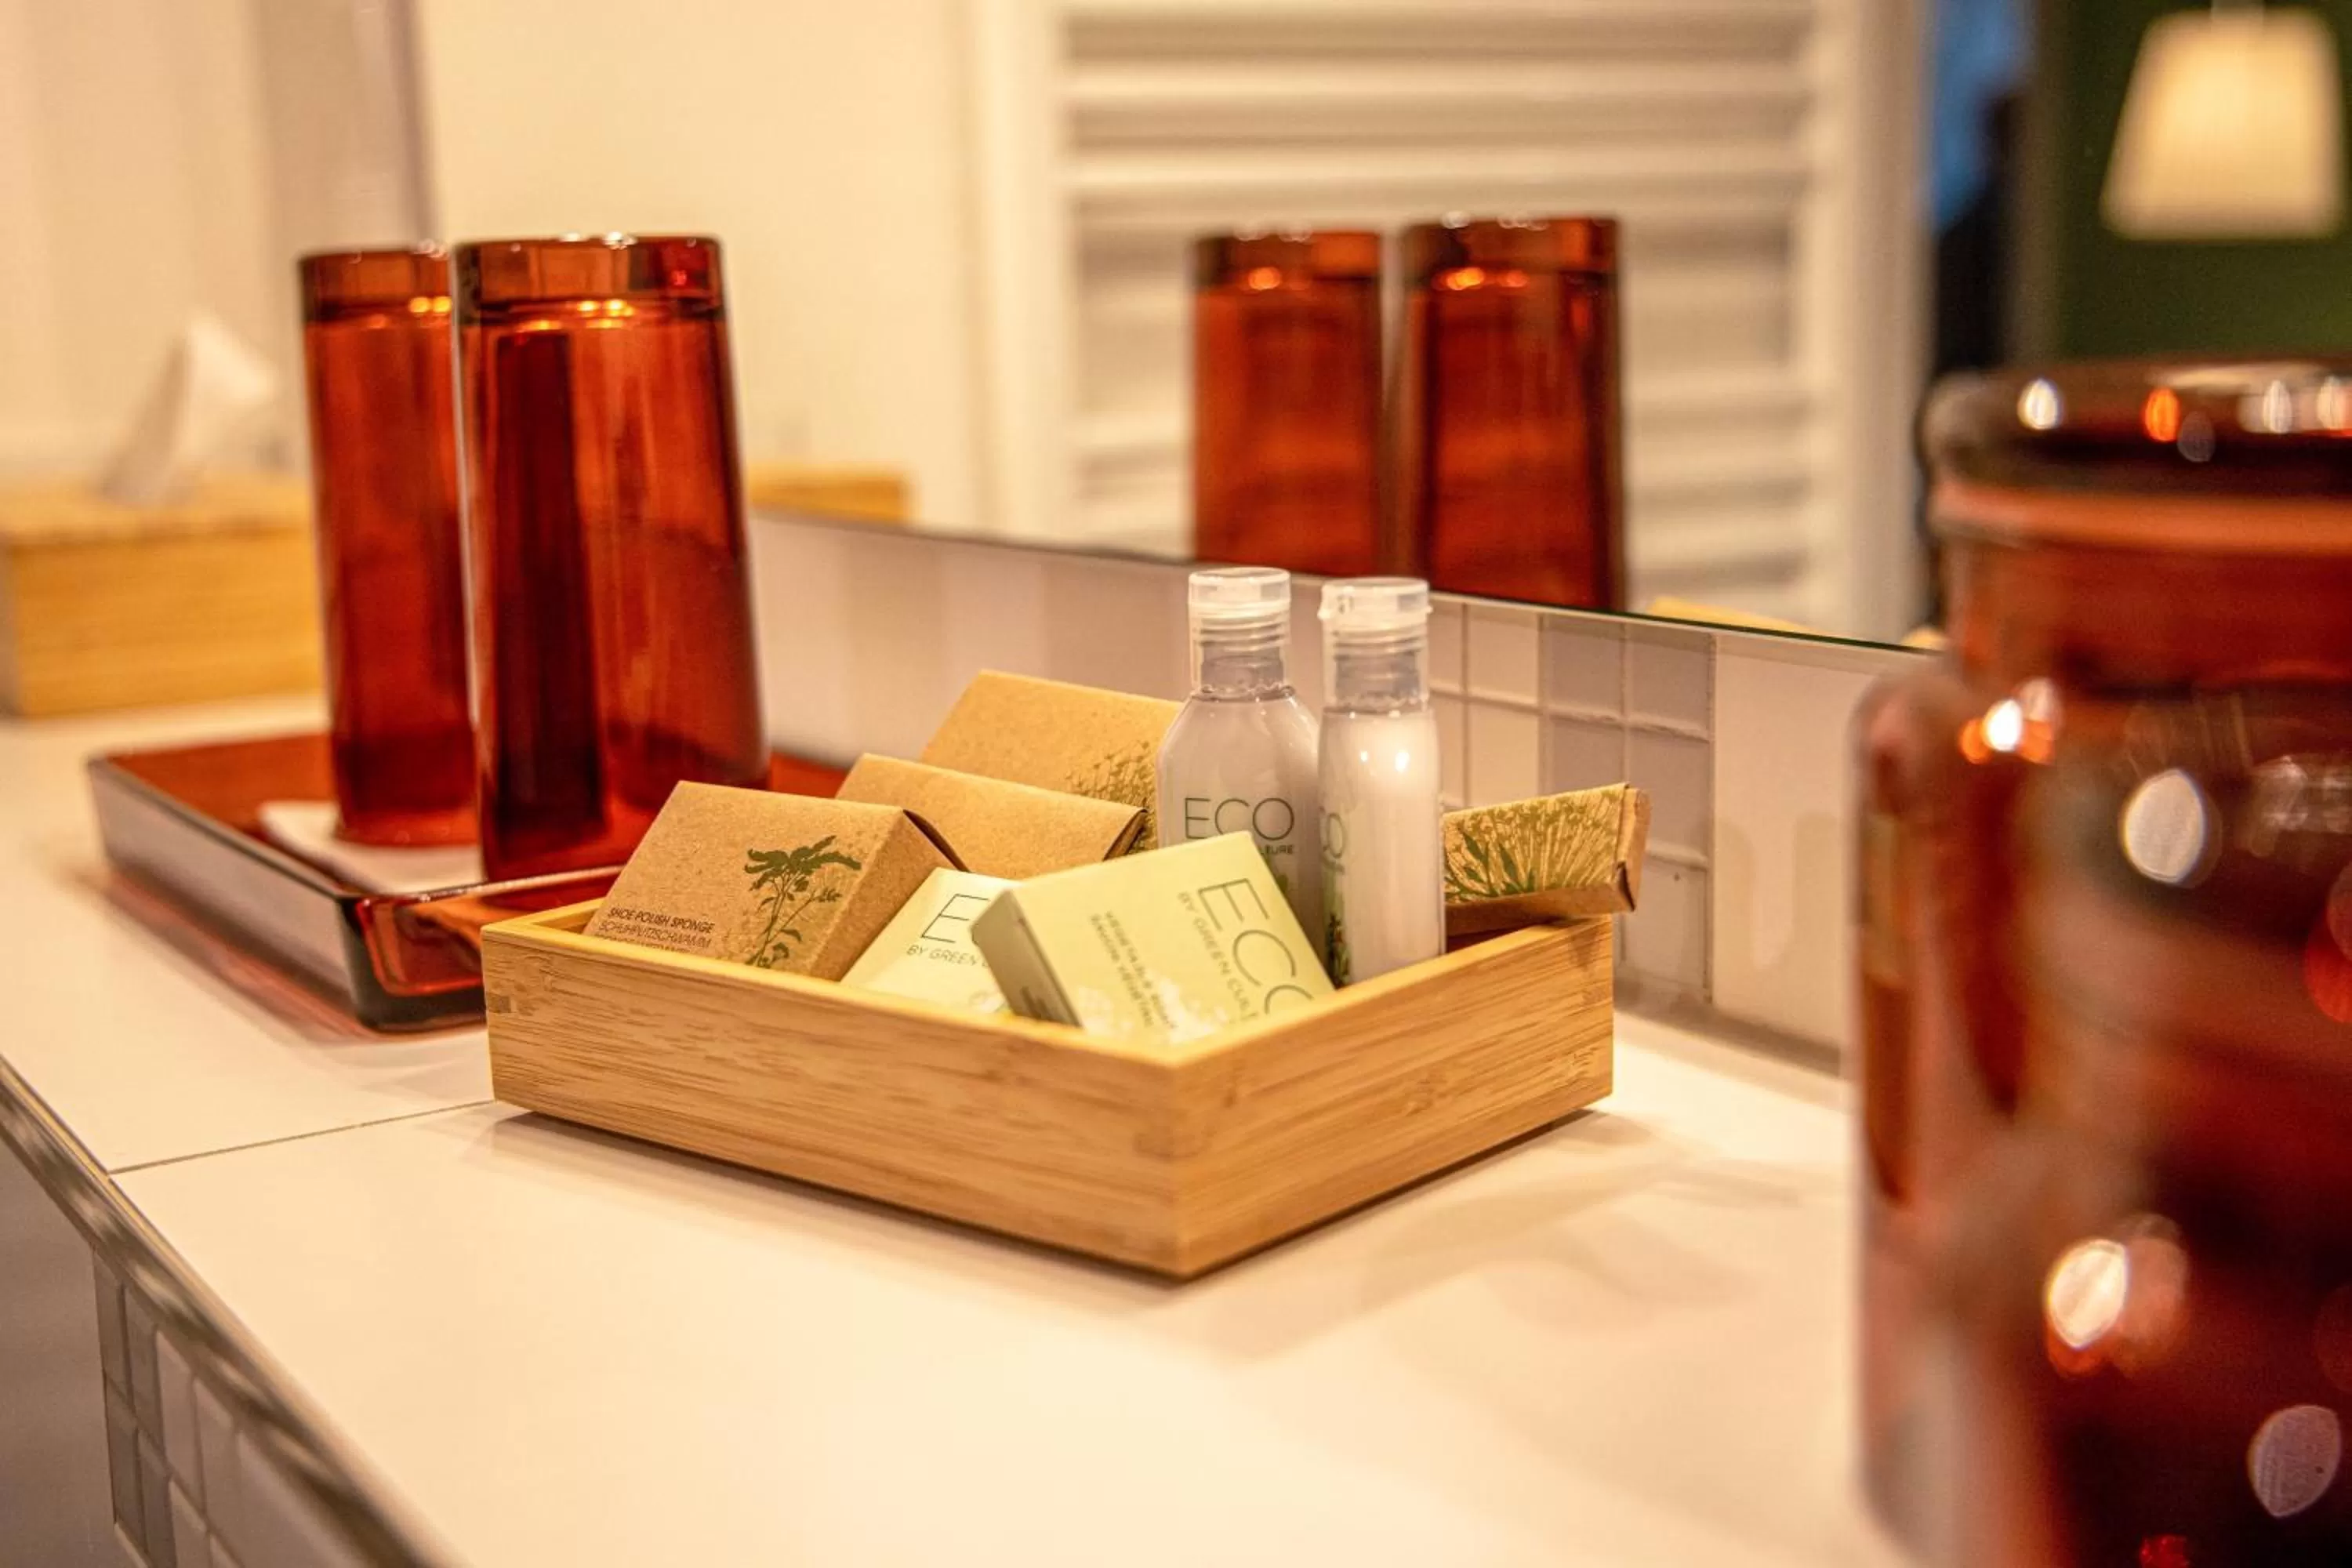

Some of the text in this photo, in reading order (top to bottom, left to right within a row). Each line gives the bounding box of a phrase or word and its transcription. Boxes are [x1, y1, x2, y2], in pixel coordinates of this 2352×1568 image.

[1185, 797, 1294, 840] ECO
[608, 907, 716, 934] SHOE POLISH SPONGE
[929, 948, 979, 966] GREEN
[1193, 916, 1231, 976] GREEN
